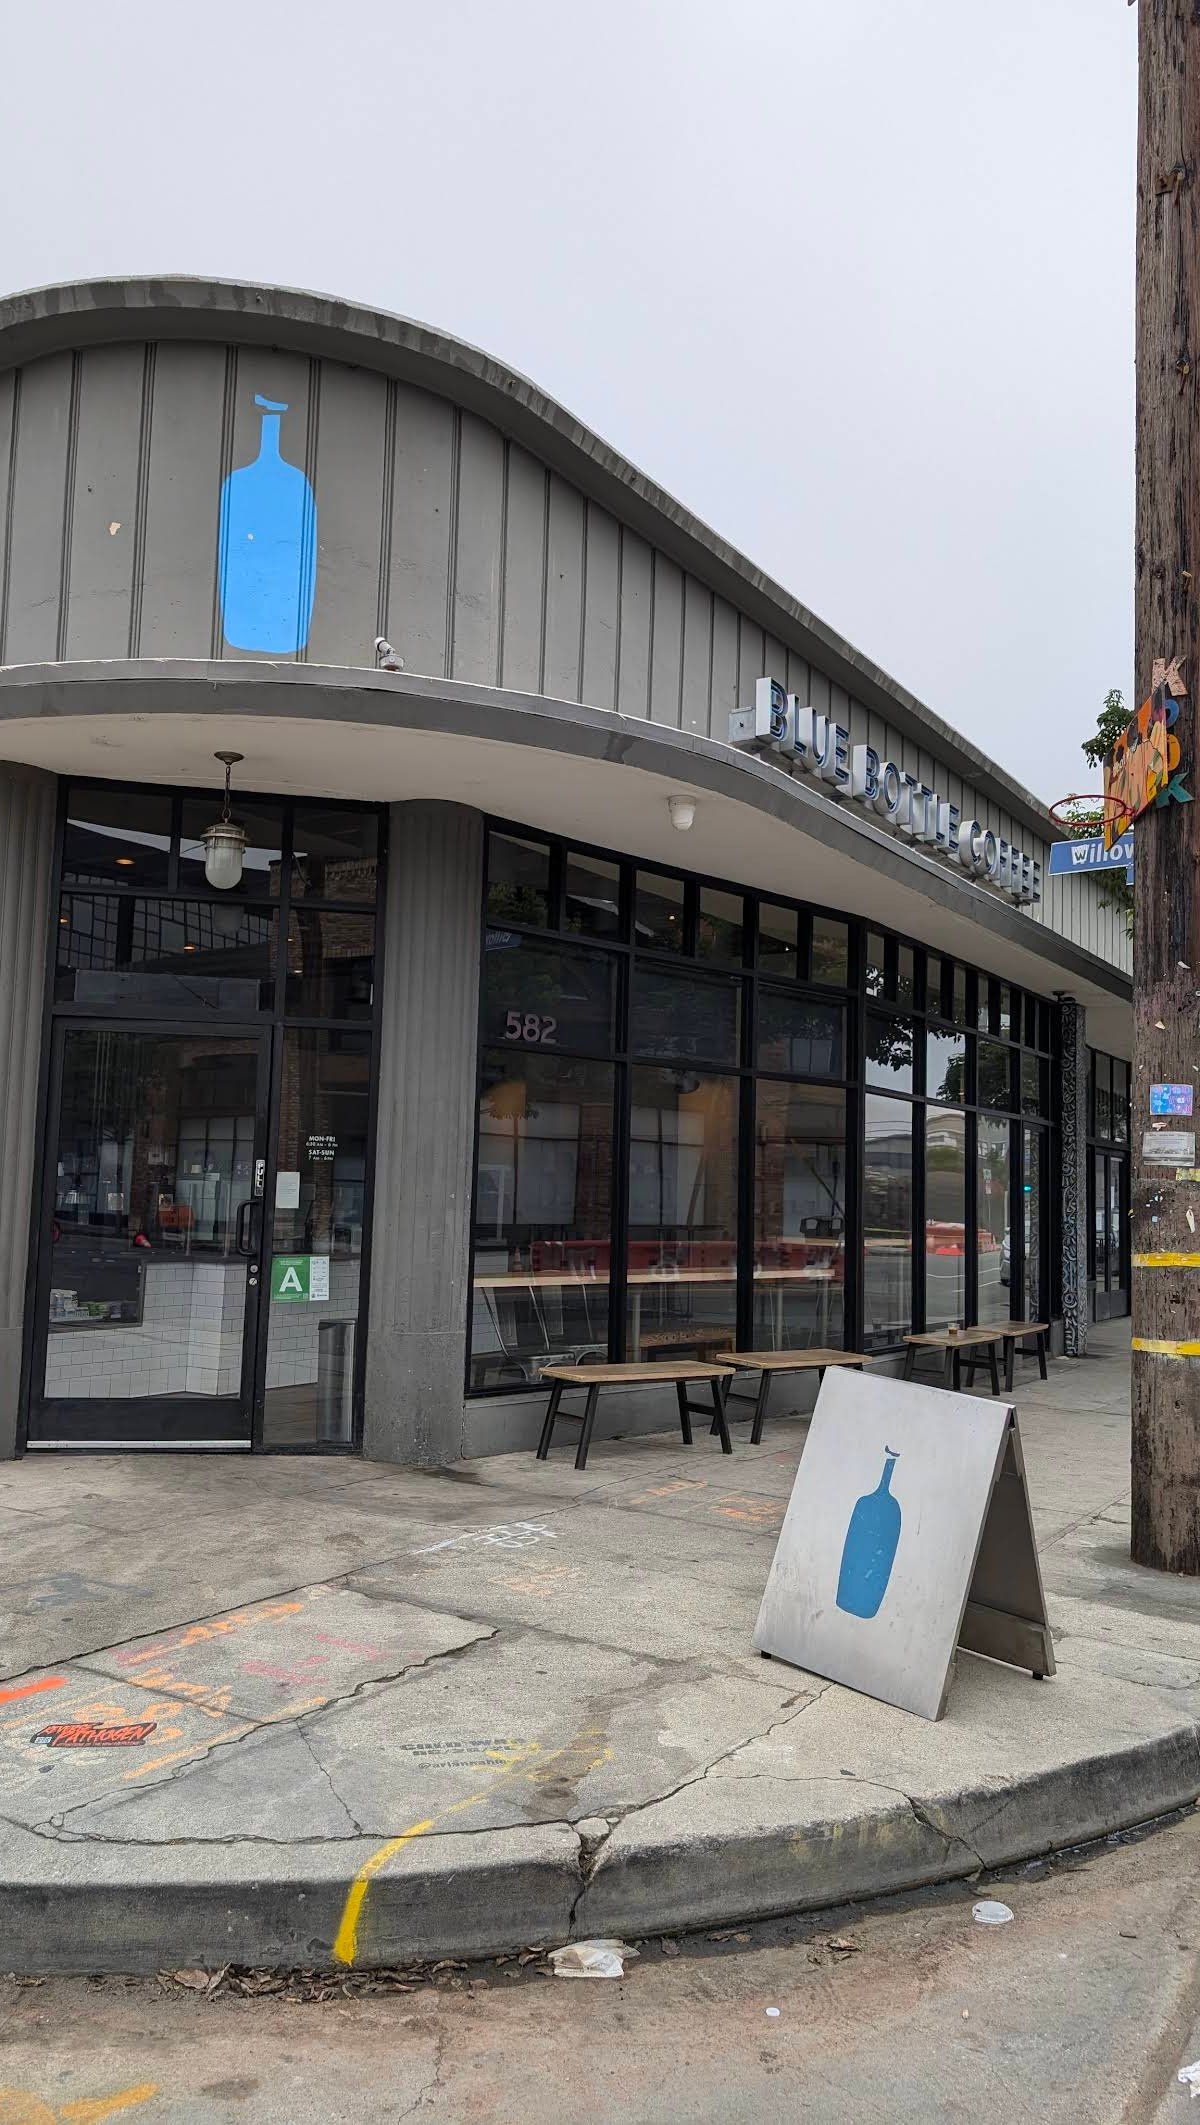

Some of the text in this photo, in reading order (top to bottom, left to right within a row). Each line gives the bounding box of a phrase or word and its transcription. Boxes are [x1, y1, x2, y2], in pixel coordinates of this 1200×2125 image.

[756, 677, 1041, 902] BLUE BOTTLE COFFEE
[505, 1010, 557, 1043] 582
[256, 1162, 264, 1187] PULL
[279, 1266, 303, 1292] A
